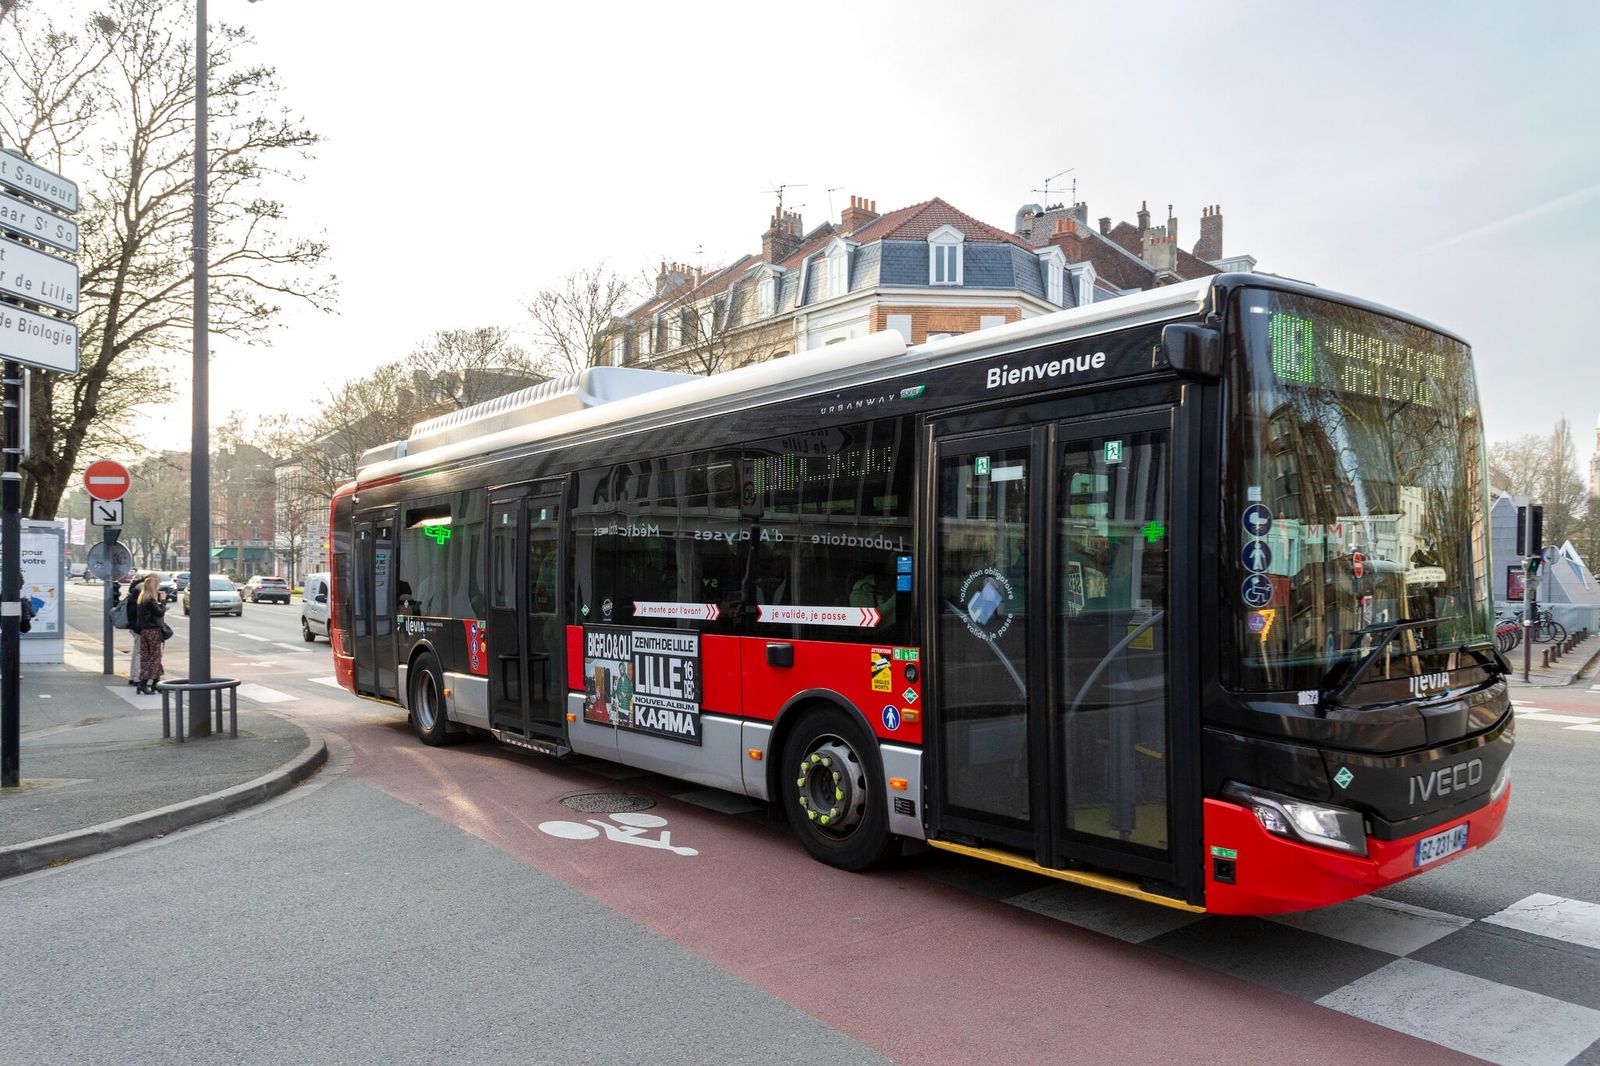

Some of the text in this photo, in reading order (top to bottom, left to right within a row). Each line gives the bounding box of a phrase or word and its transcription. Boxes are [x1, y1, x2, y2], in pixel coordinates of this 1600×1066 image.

[15, 165, 73, 203] Sauveur
[0, 204, 25, 224] aar
[56, 224, 73, 242] So
[16, 273, 32, 290] de
[41, 280, 73, 304] Lille
[18, 317, 73, 346] Biologie
[986, 351, 1106, 389] Bienvenue
[820, 394, 895, 415] URBANWAY
[21, 549, 44, 557] pour
[960, 566, 1014, 602] validation obligatoire
[641, 604, 702, 616] je monte par l'avant
[771, 609, 847, 622] je valide, je passe
[997, 613, 1013, 637] passe
[587, 632, 613, 659] BIGFLO
[634, 636, 694, 653] ZENITH DE LILLE
[634, 654, 683, 698] LILLE
[684, 660, 694, 680] 16
[684, 680, 695, 700] DEC
[635, 696, 695, 712] NOUVEL ALBUM
[1409, 758, 1483, 805] IVECO
